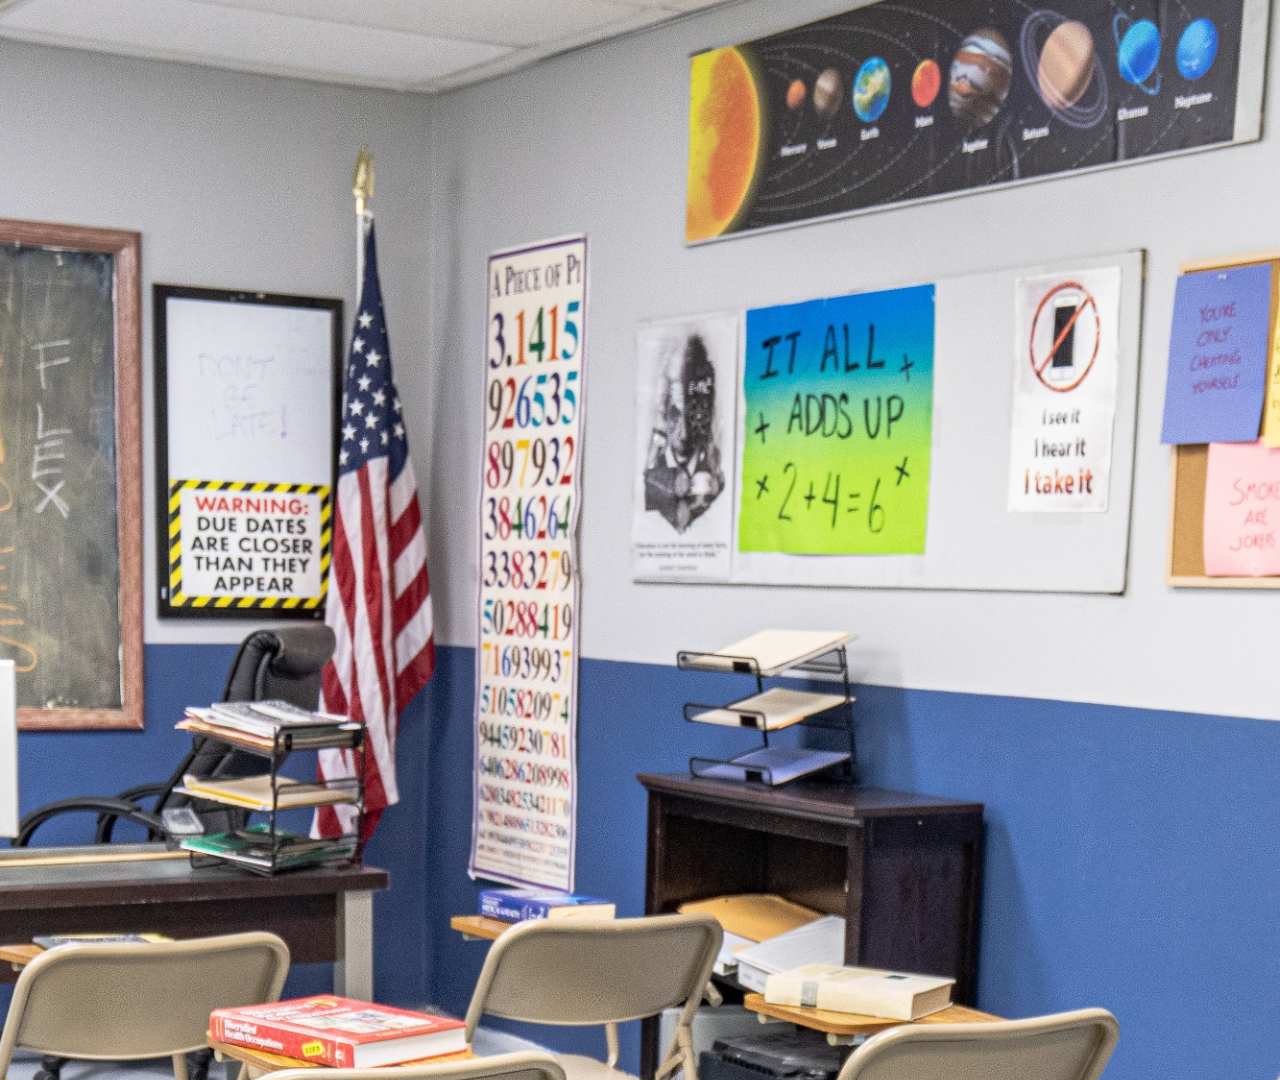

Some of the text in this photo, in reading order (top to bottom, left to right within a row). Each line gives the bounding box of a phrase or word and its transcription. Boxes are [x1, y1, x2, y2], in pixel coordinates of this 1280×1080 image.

[491, 270, 501, 297] A
[490, 301, 580, 369] 3.1415
[758, 324, 886, 381] IT ALL
[488, 371, 578, 431] 926535
[786, 392, 906, 441] ADDS UP
[30, 338, 73, 520] FLEX
[1042, 438, 1071, 457] hear
[1075, 437, 1086, 457] it
[486, 435, 575, 490] 897932
[1024, 468, 1093, 495] I take it
[194, 495, 310, 516] WARNING:
[197, 516, 307, 535] DUE DATES
[485, 495, 571, 541] 3846264
[191, 536, 313, 555] ARE CLOSER
[194, 556, 310, 574] THAN THEY
[214, 577, 294, 592] APPEAR
[484, 550, 571, 592] 3383279
[482, 599, 572, 641] 50288419
[482, 642, 571, 686] 716939937
[480, 684, 570, 725] 5105820974
